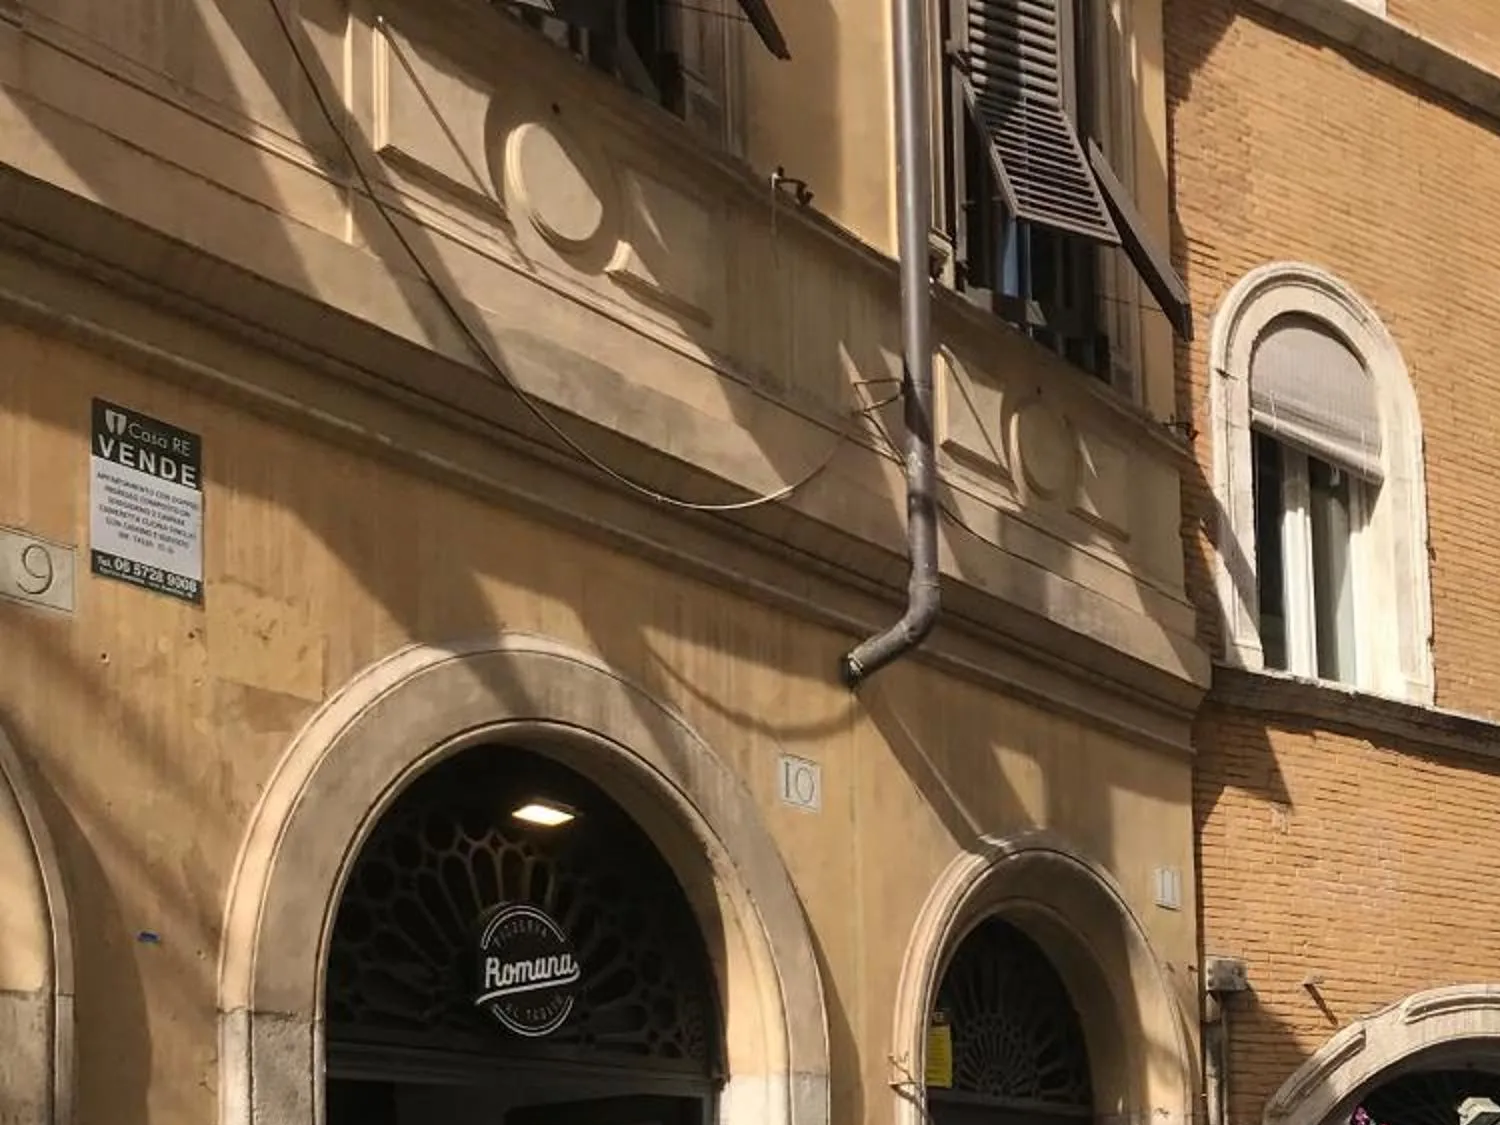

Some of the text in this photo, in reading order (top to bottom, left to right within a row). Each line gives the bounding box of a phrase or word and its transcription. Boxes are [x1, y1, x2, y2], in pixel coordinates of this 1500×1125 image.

[98, 433, 197, 488] VENDE
[16, 543, 53, 595] 9
[784, 761, 815, 804] 10
[484, 953, 578, 990] Romana
